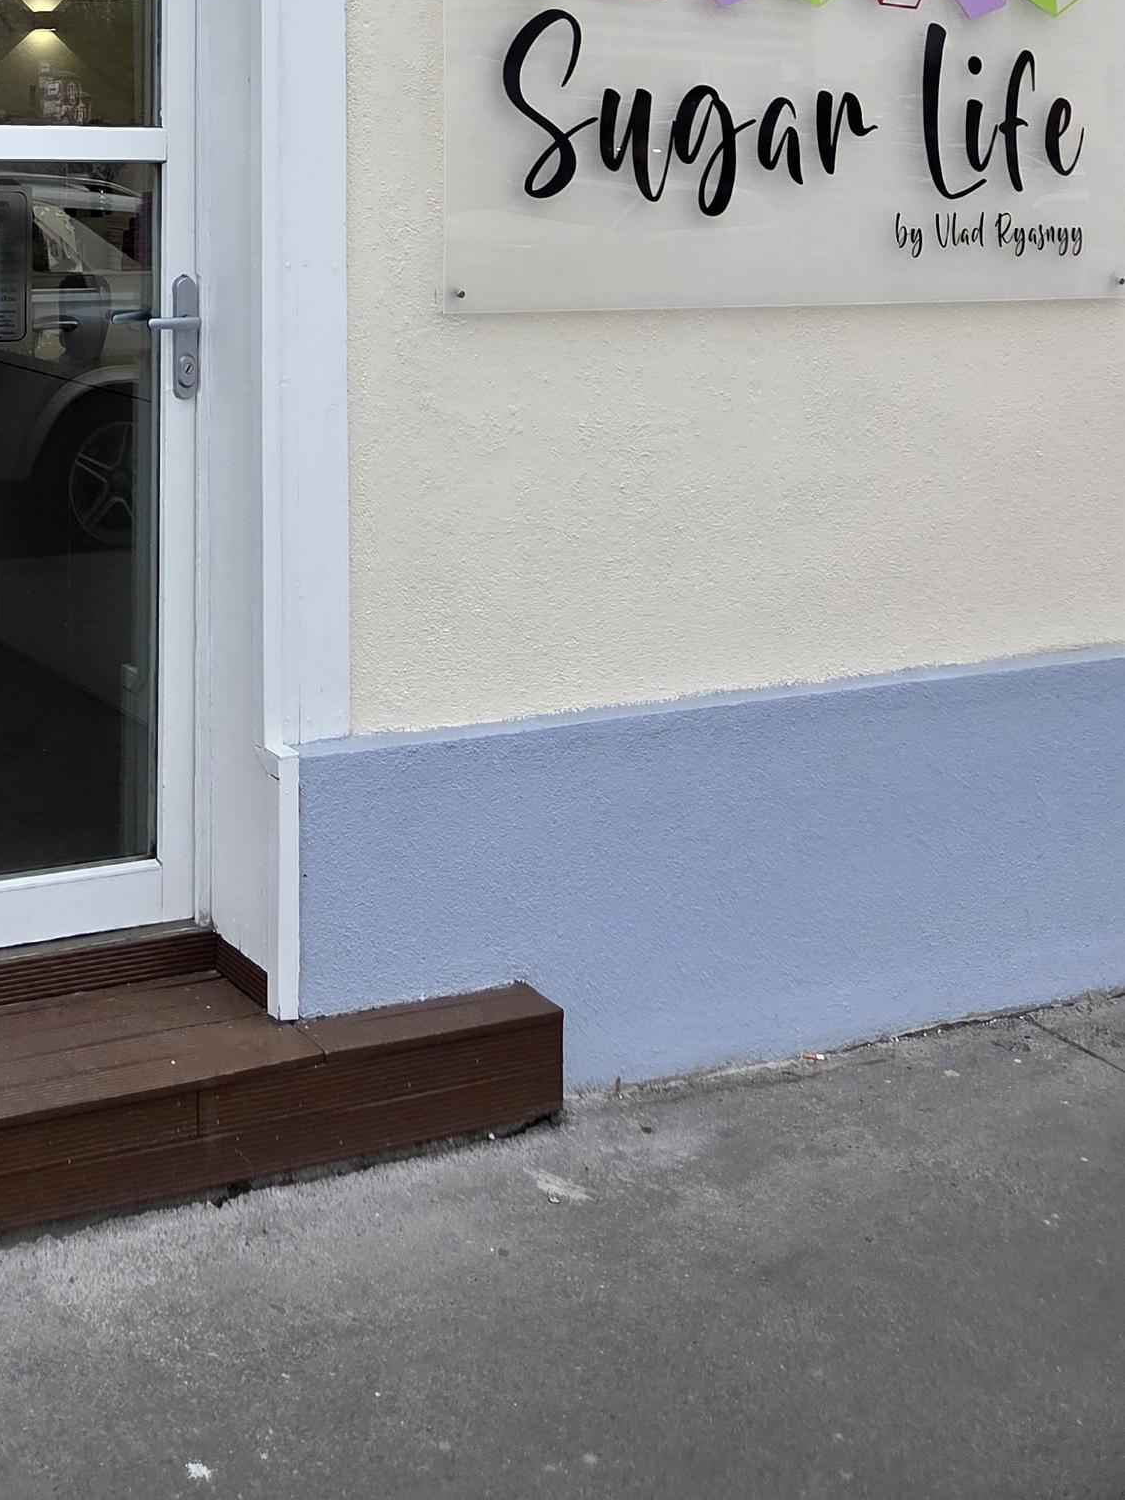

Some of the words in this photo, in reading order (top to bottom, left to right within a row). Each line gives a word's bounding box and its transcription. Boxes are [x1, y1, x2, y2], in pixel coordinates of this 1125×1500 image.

[502, 7, 878, 217] Sugar
[922, 22, 1084, 199] Life
[895, 212, 923, 258] by
[935, 212, 984, 248] Vlad
[994, 212, 1083, 257] Ryasnyy
